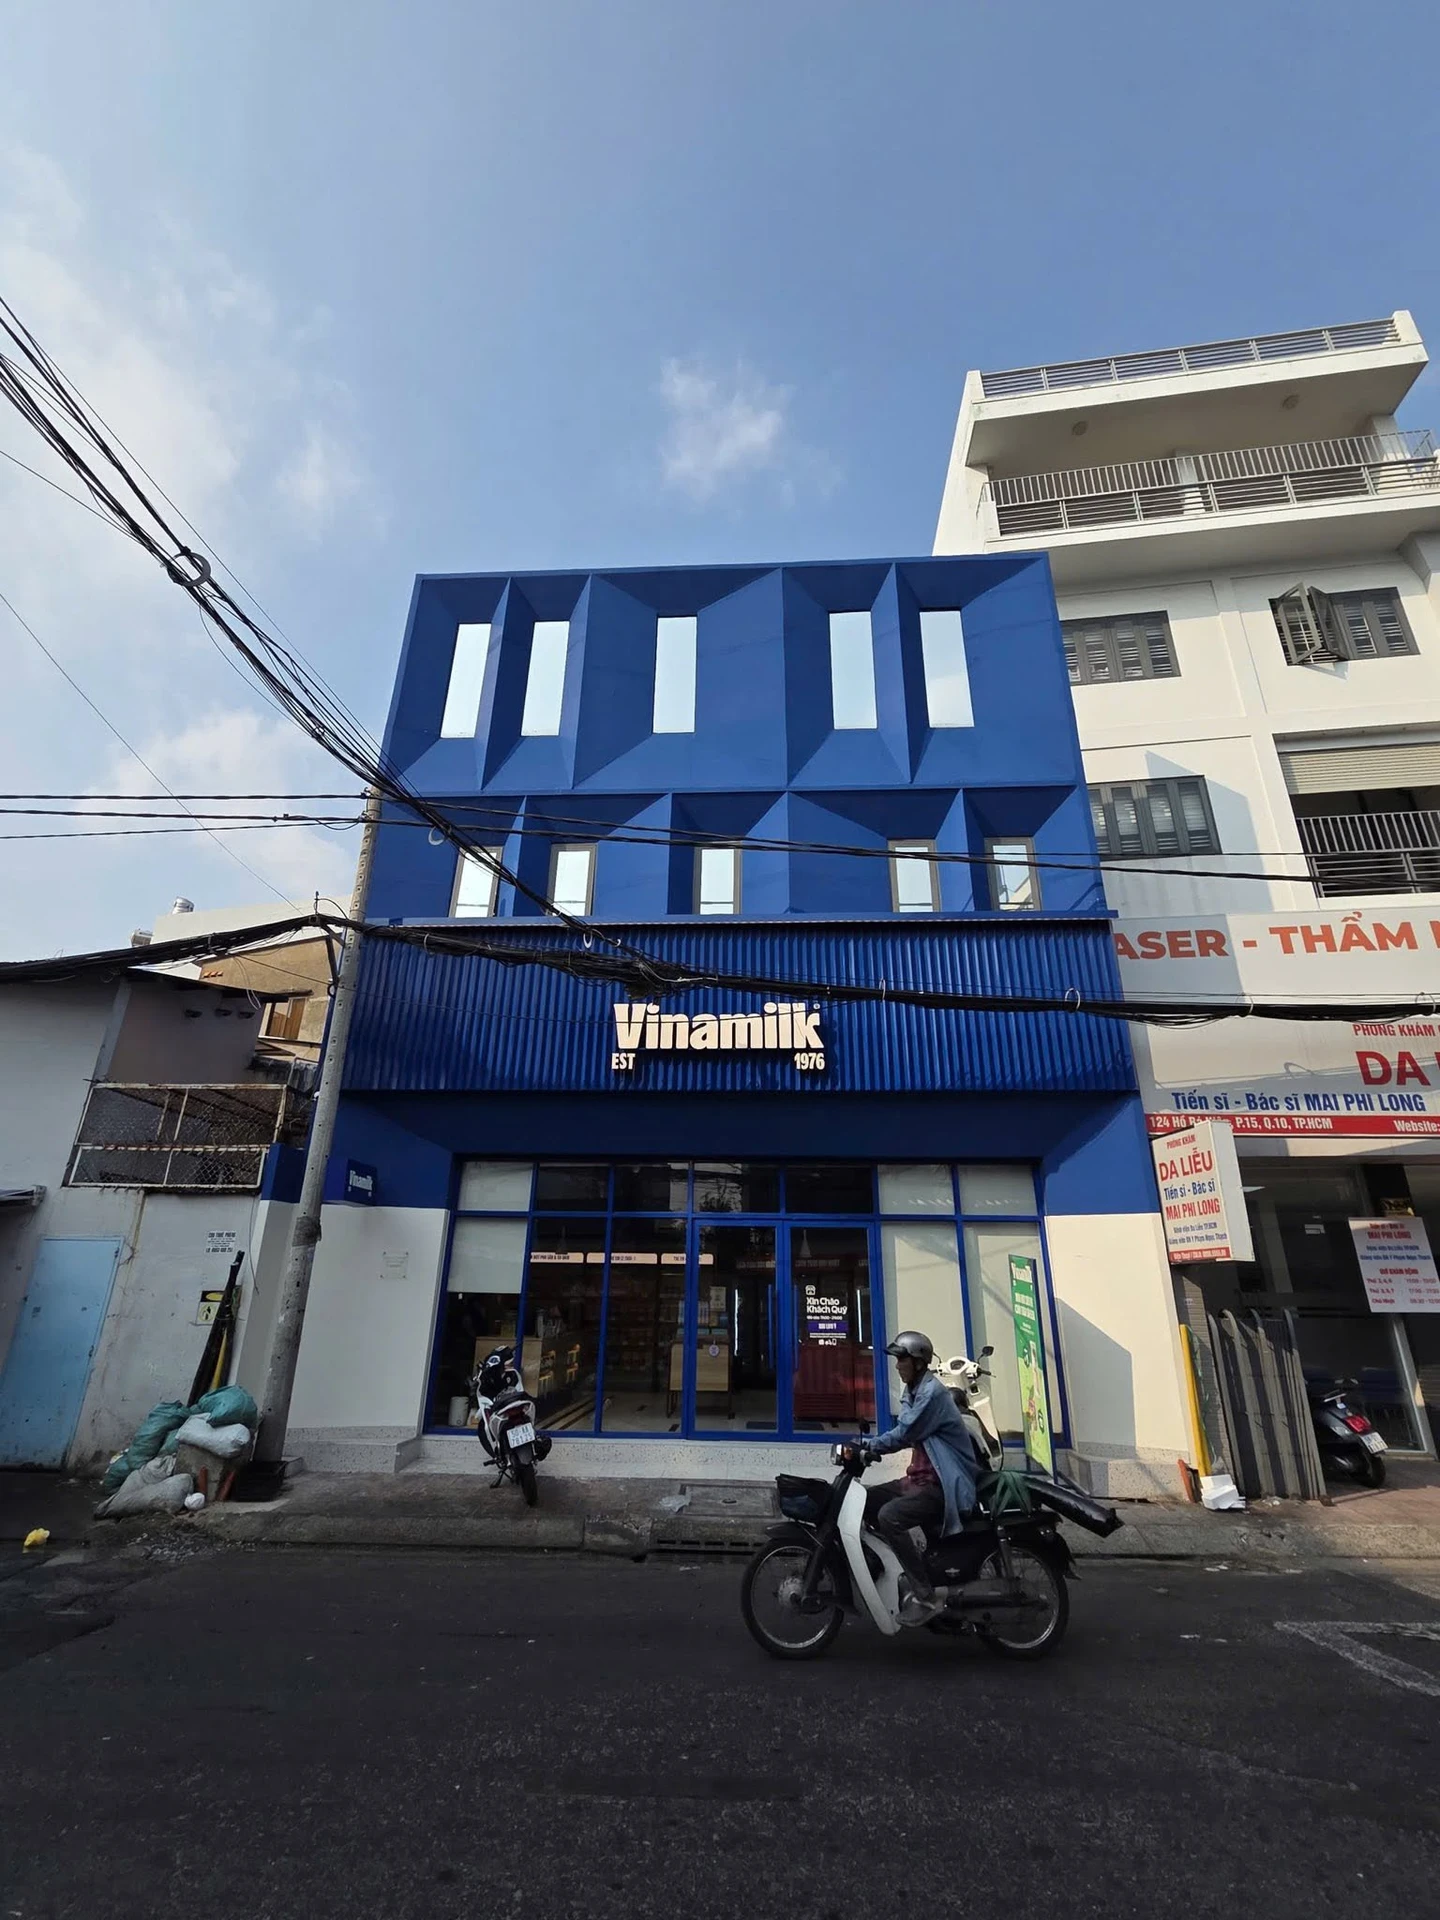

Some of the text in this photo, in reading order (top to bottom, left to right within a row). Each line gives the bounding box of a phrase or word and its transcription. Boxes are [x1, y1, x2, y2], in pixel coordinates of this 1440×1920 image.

[1242, 939, 1258, 948] -
[1269, 911, 1419, 954] THẨM
[613, 1001, 824, 1050] Vinamilk
[1398, 1022, 1436, 1037] KHÁM
[611, 1053, 636, 1070] EST
[794, 1052, 825, 1071] 1976
[1355, 1050, 1431, 1087] DA
[1171, 1090, 1209, 1110] Tiến
[1214, 1093, 1229, 1110] sĩ
[1247, 1093, 1279, 1111] Bác
[1285, 1094, 1300, 1111] sĩ
[1303, 1093, 1340, 1111] MAI
[1343, 1093, 1375, 1111] PHI
[1378, 1094, 1426, 1112] LONG
[1150, 1117, 1170, 1128] 124
[1236, 1117, 1262, 1130] P.15,
[1263, 1117, 1291, 1130] Q.10,
[1292, 1117, 1333, 1130] TP.HCM
[1393, 1120, 1440, 1132] Website:
[1159, 1148, 1213, 1182] DA LIỄU
[1163, 1185, 1178, 1200] Tiến
[1192, 1182, 1207, 1196] Bác
[1165, 1198, 1221, 1220] MAI PHI LONG
[806, 1297, 819, 1305] Xin
